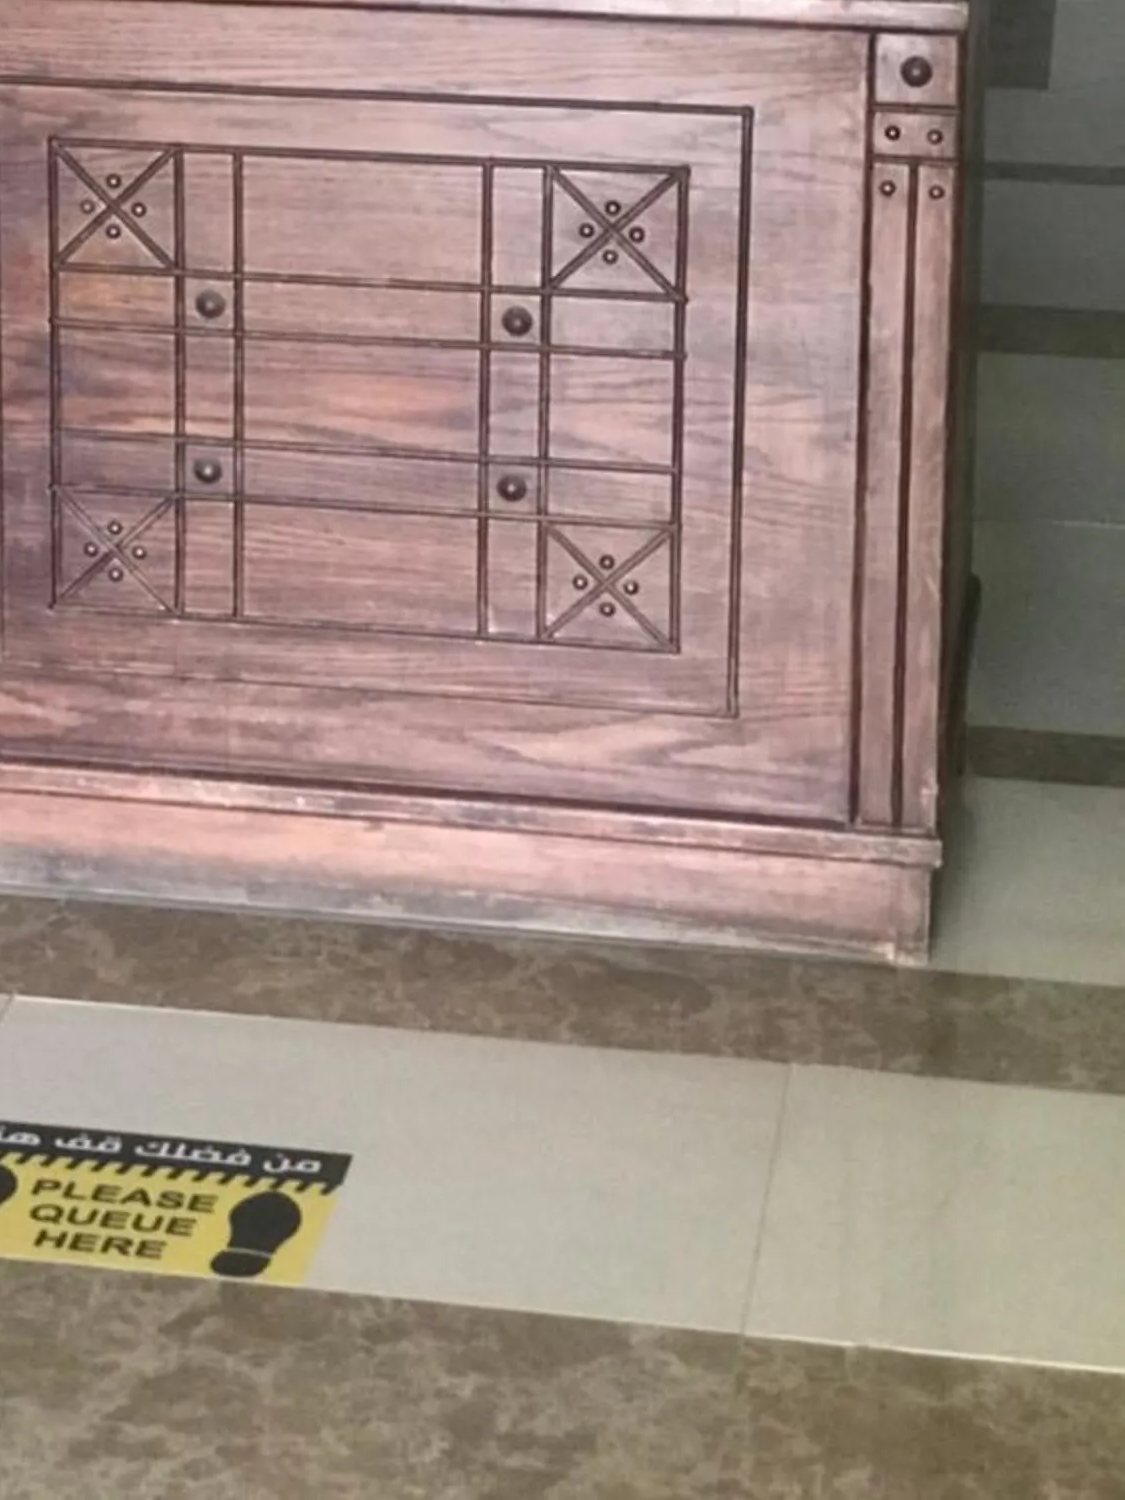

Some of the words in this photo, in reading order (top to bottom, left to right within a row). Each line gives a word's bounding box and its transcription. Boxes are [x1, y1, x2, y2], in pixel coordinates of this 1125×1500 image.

[55, 1132, 122, 1154] قف
[135, 1138, 251, 1167] فضلك
[263, 1154, 322, 1173] من
[31, 1178, 219, 1214] PLEASE
[29, 1203, 197, 1237] QUEUE
[34, 1229, 168, 1260] HERE
